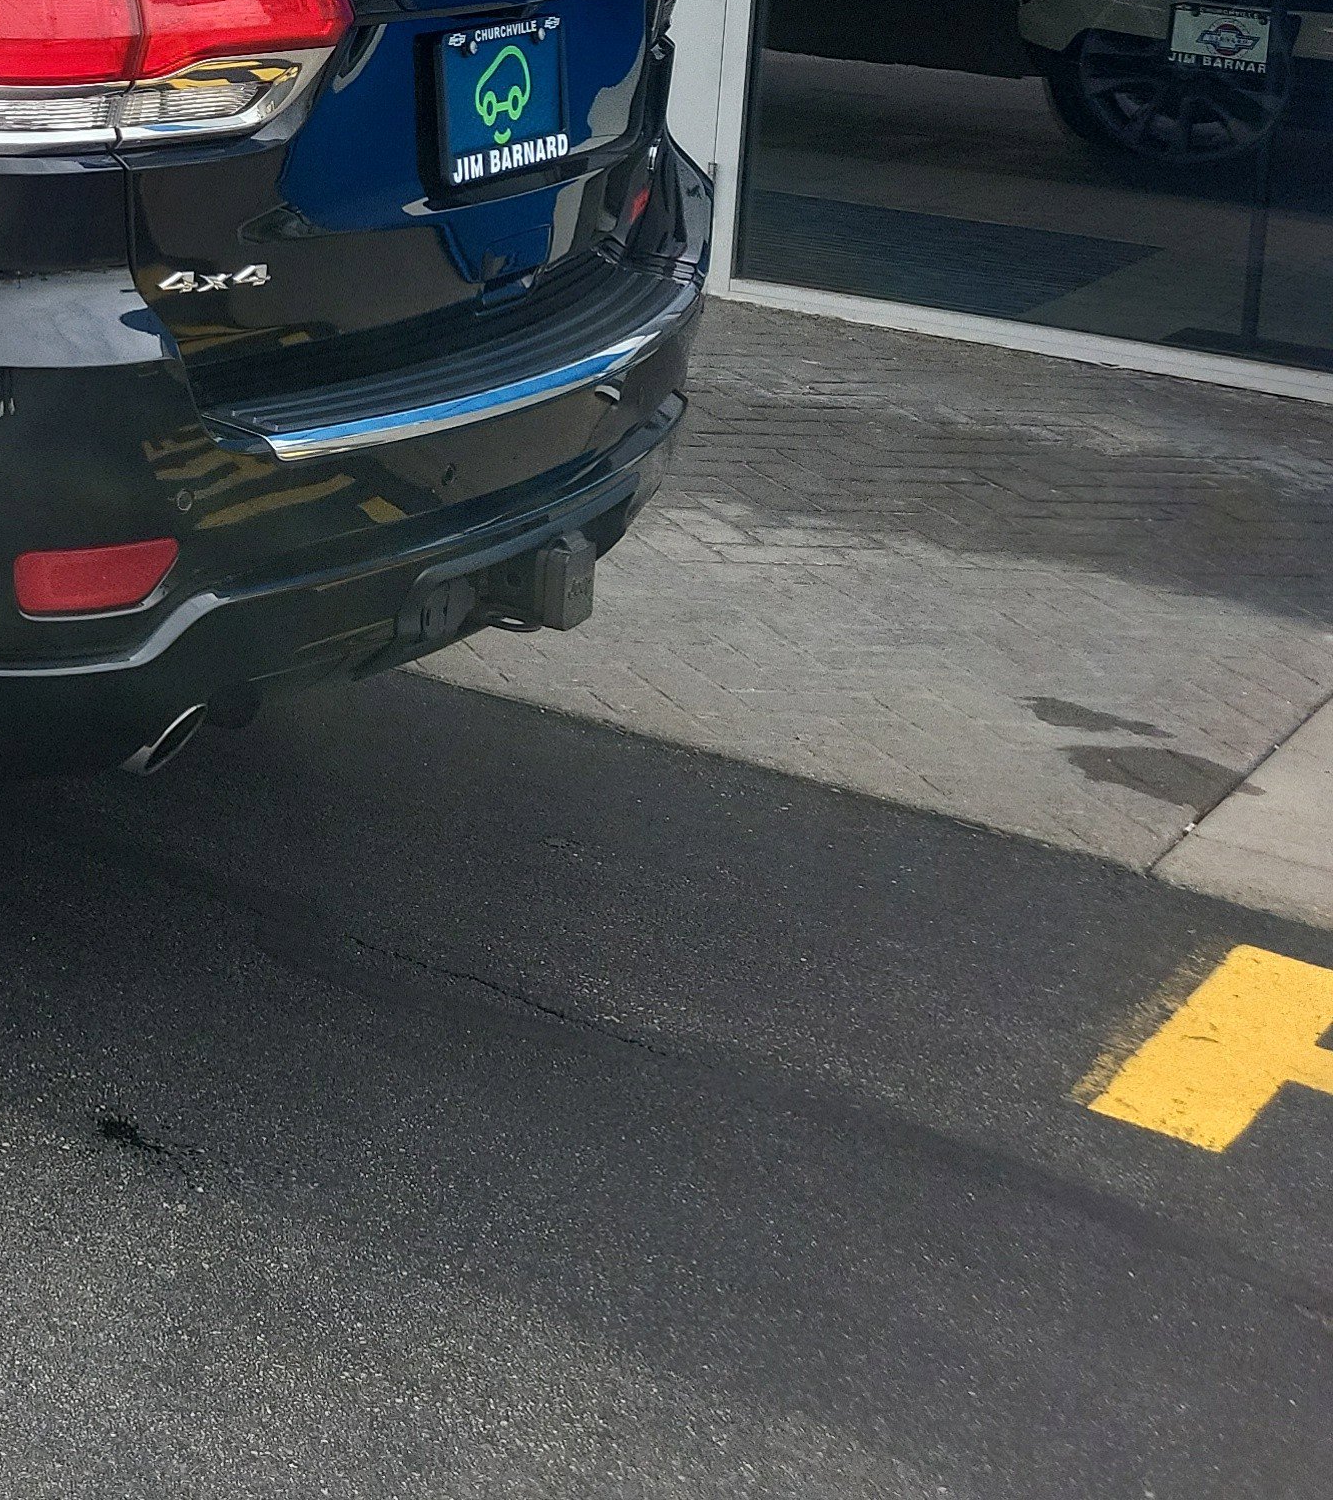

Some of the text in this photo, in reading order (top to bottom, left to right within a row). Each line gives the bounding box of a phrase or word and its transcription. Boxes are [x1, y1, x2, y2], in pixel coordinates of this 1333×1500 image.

[474, 20, 537, 42] CHURCHVILLE
[1167, 52, 1195, 64] JIM
[452, 133, 569, 184] JIM BARNARD
